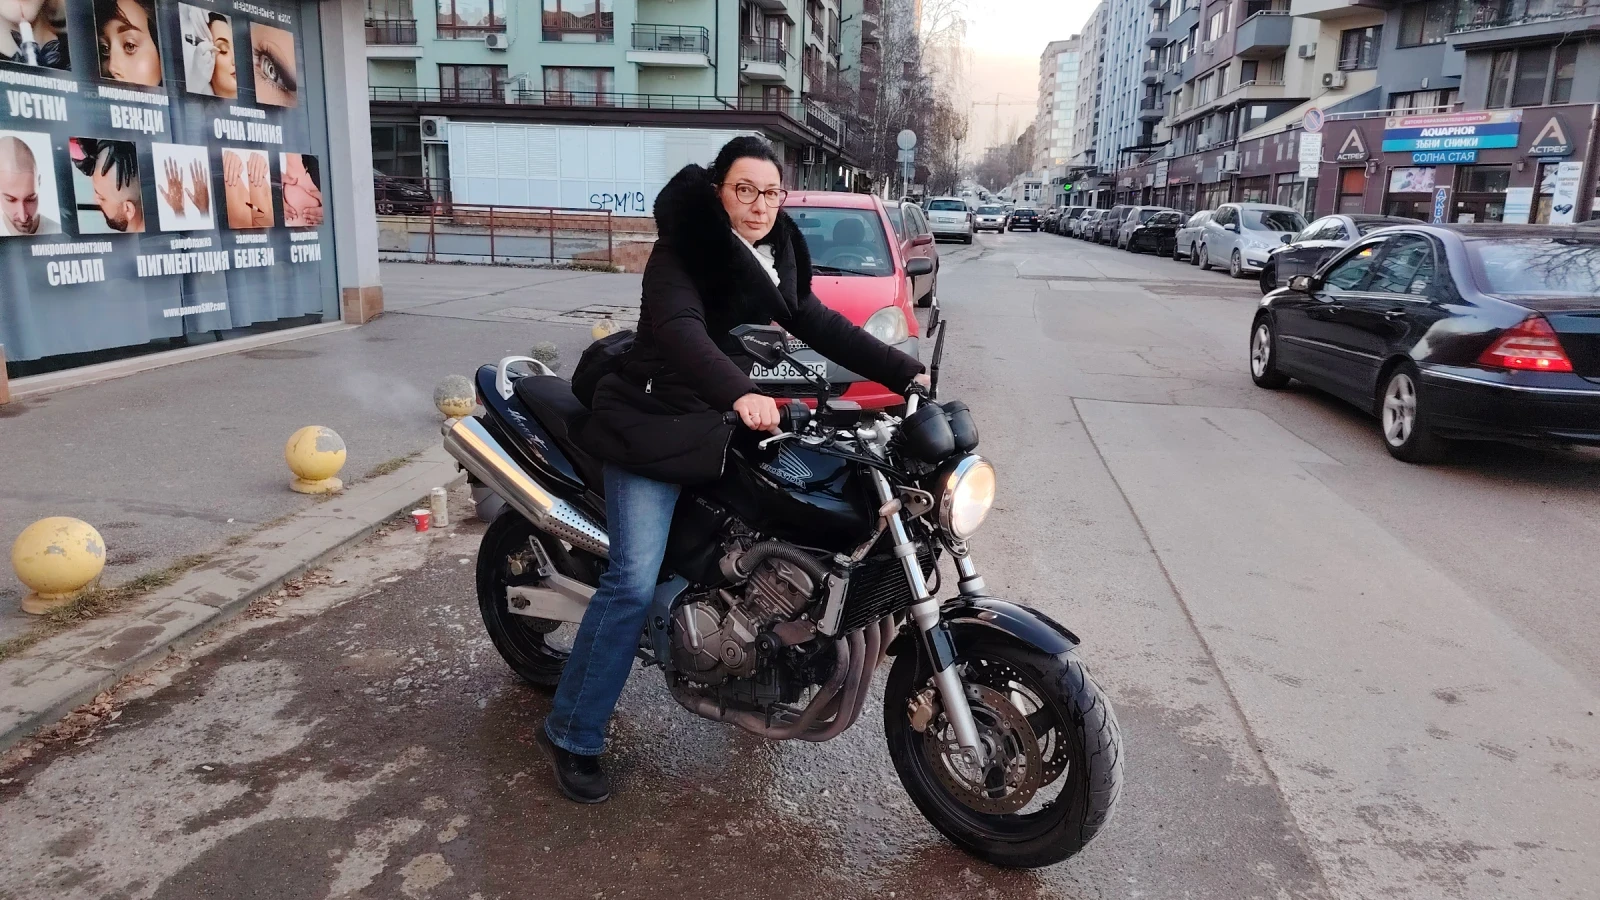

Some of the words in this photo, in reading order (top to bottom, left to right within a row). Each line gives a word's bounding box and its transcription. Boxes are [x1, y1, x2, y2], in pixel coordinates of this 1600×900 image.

[6, 90, 68, 121] УСТНИ
[98, 85, 169, 106] микропигментация
[110, 104, 165, 135] ВЕЖДИ
[213, 118, 246, 141] ОЧНА
[247, 121, 283, 145] ЛИНИЯ
[1420, 126, 1476, 137] AQUAPHOR
[1415, 139, 1440, 149] ЗЪБНИ
[1444, 137, 1479, 148] СНИМКИ
[1412, 153, 1446, 163] СОЛНА
[1448, 151, 1475, 161] СТАЯ
[31, 241, 113, 257] микропигментация
[233, 247, 275, 269] БЕЛЕЗИ
[290, 243, 321, 263] СТРИИ
[46, 258, 105, 287] СКАЛП
[136, 250, 230, 278] ПИГМЕНТАЦИЯ
[772, 364, 803, 377] 036
